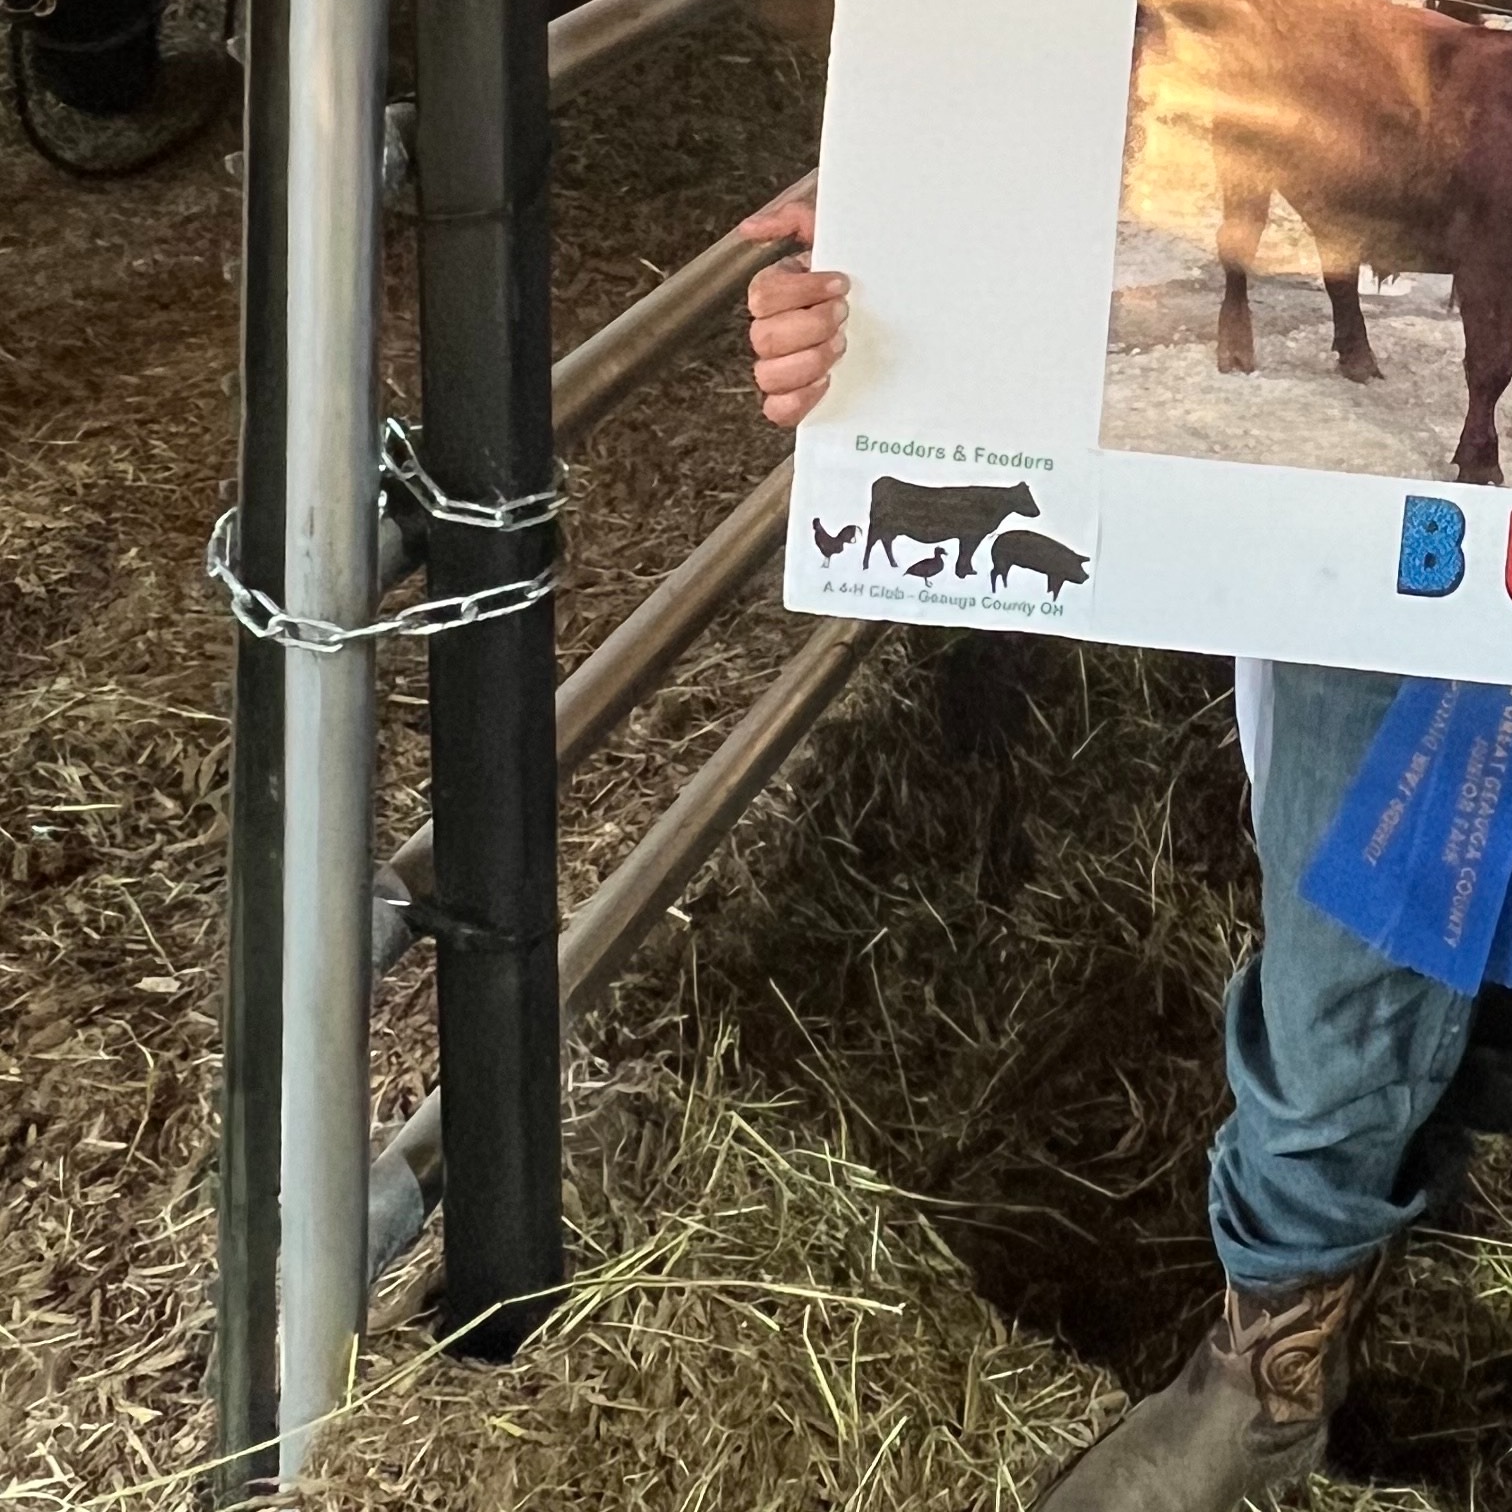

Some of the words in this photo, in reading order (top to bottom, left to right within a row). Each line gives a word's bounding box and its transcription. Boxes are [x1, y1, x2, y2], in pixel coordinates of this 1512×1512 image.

[855, 435, 946, 460] Breeders
[953, 444, 967, 462] &
[974, 447, 1054, 471] Feeders
[823, 581, 834, 592] A
[869, 585, 905, 601] Club
[981, 595, 1036, 617] County
[1040, 602, 1064, 617] OH
